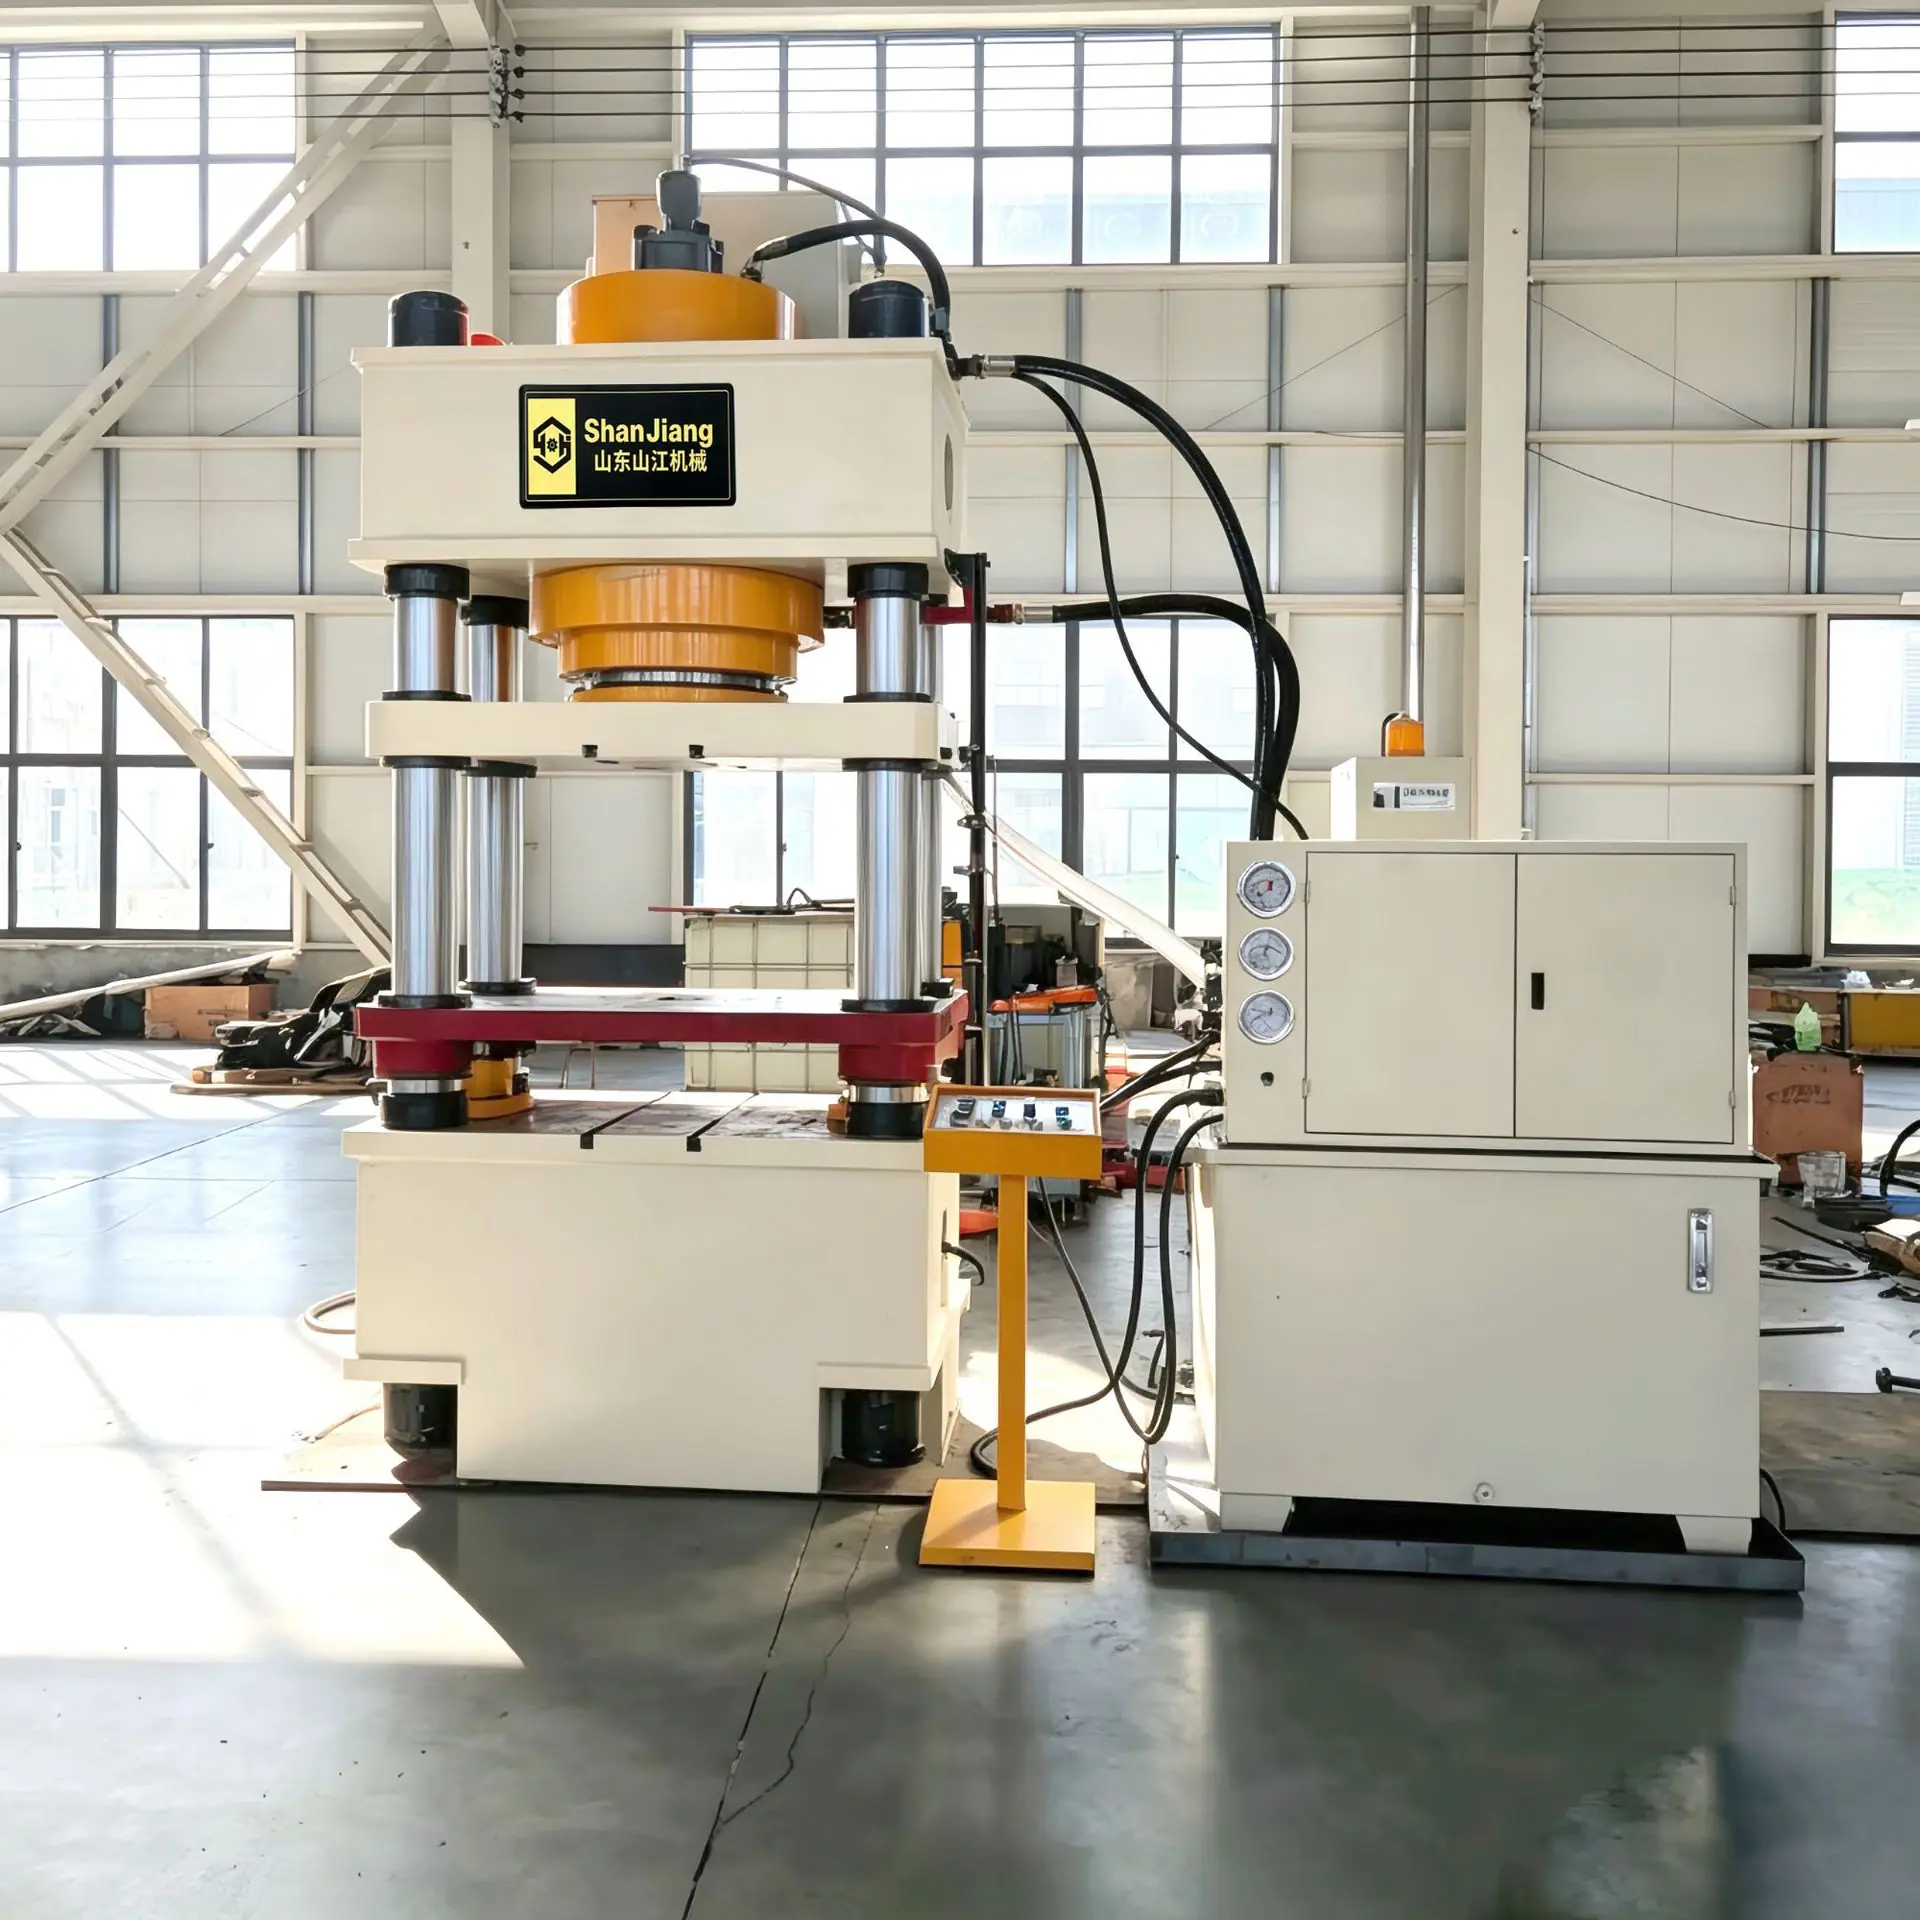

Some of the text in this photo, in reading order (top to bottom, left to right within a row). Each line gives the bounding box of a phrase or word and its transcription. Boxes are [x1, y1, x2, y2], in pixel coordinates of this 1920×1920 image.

[584, 418, 713, 448] ShanJiang
[594, 449, 708, 473] 山东山江机械
